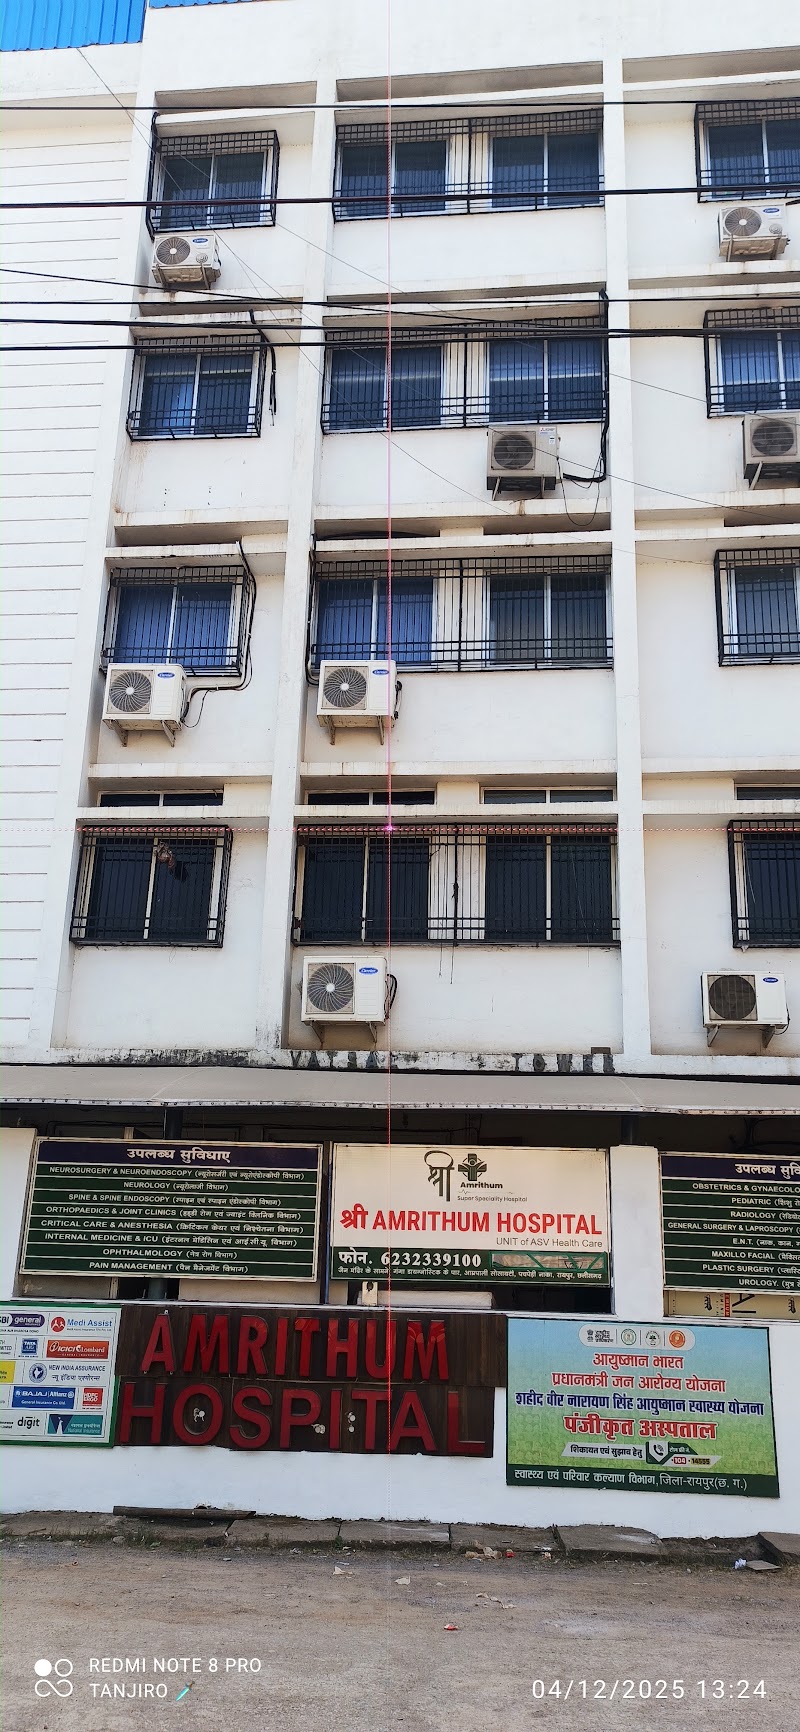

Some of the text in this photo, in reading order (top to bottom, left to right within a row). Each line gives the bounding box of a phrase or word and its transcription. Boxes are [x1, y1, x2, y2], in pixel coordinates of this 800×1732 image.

[127, 1147, 230, 1163] उपलब्ध सुविधाए
[282, 1172, 304, 1180] विभाग)
[424, 1150, 454, 1202] श्री
[735, 1164, 776, 1175] उपलब्ध
[206, 1183, 229, 1191] विभाग)
[259, 1198, 281, 1206] विभाग)
[277, 1211, 301, 1220] विभाग)
[340, 1203, 602, 1235] श्री AMRITHUM HOSPITAL
[278, 1225, 304, 1234] विभाग)
[271, 1238, 298, 1247] विभाग)
[496, 1237, 518, 1246] UNIT
[521, 1237, 529, 1246] of
[530, 1238, 550, 1246] ASV
[552, 1239, 579, 1247] Health
[202, 1250, 212, 1258] रोग
[215, 1251, 237, 1260] विभाग)
[339, 1247, 481, 1267] फोन. 6232339100
[222, 1265, 249, 1274] विभाग)
[15, 1316, 41, 1324] general
[140, 1314, 449, 1380] AMRITHUM
[593, 1352, 683, 1371] आयुष्मान भारत
[552, 1372, 726, 1392] प्रधानमंत्री जन आरोग्य योजना
[515, 1391, 543, 1406] शहीद
[547, 1391, 563, 1407] वीर
[568, 1394, 609, 1408] नारायण
[613, 1393, 633, 1410] सिंह
[637, 1398, 685, 1415] आयुष्मान
[728, 1399, 764, 1415] योजना
[18, 1417, 40, 1429] digit
[120, 1382, 485, 1453] HOSPITAL
[565, 1413, 717, 1441] पंजीकृत अस्पताल
[570, 1444, 643, 1458] शिकायत एवं सुझाव हेतु
[515, 1470, 543, 1480] स्वास्थ्य
[548, 1470, 559, 1481] एवं
[563, 1470, 590, 1482] परिवार
[594, 1473, 625, 1484] कल्याण
[733, 1478, 747, 1491] ग.)
